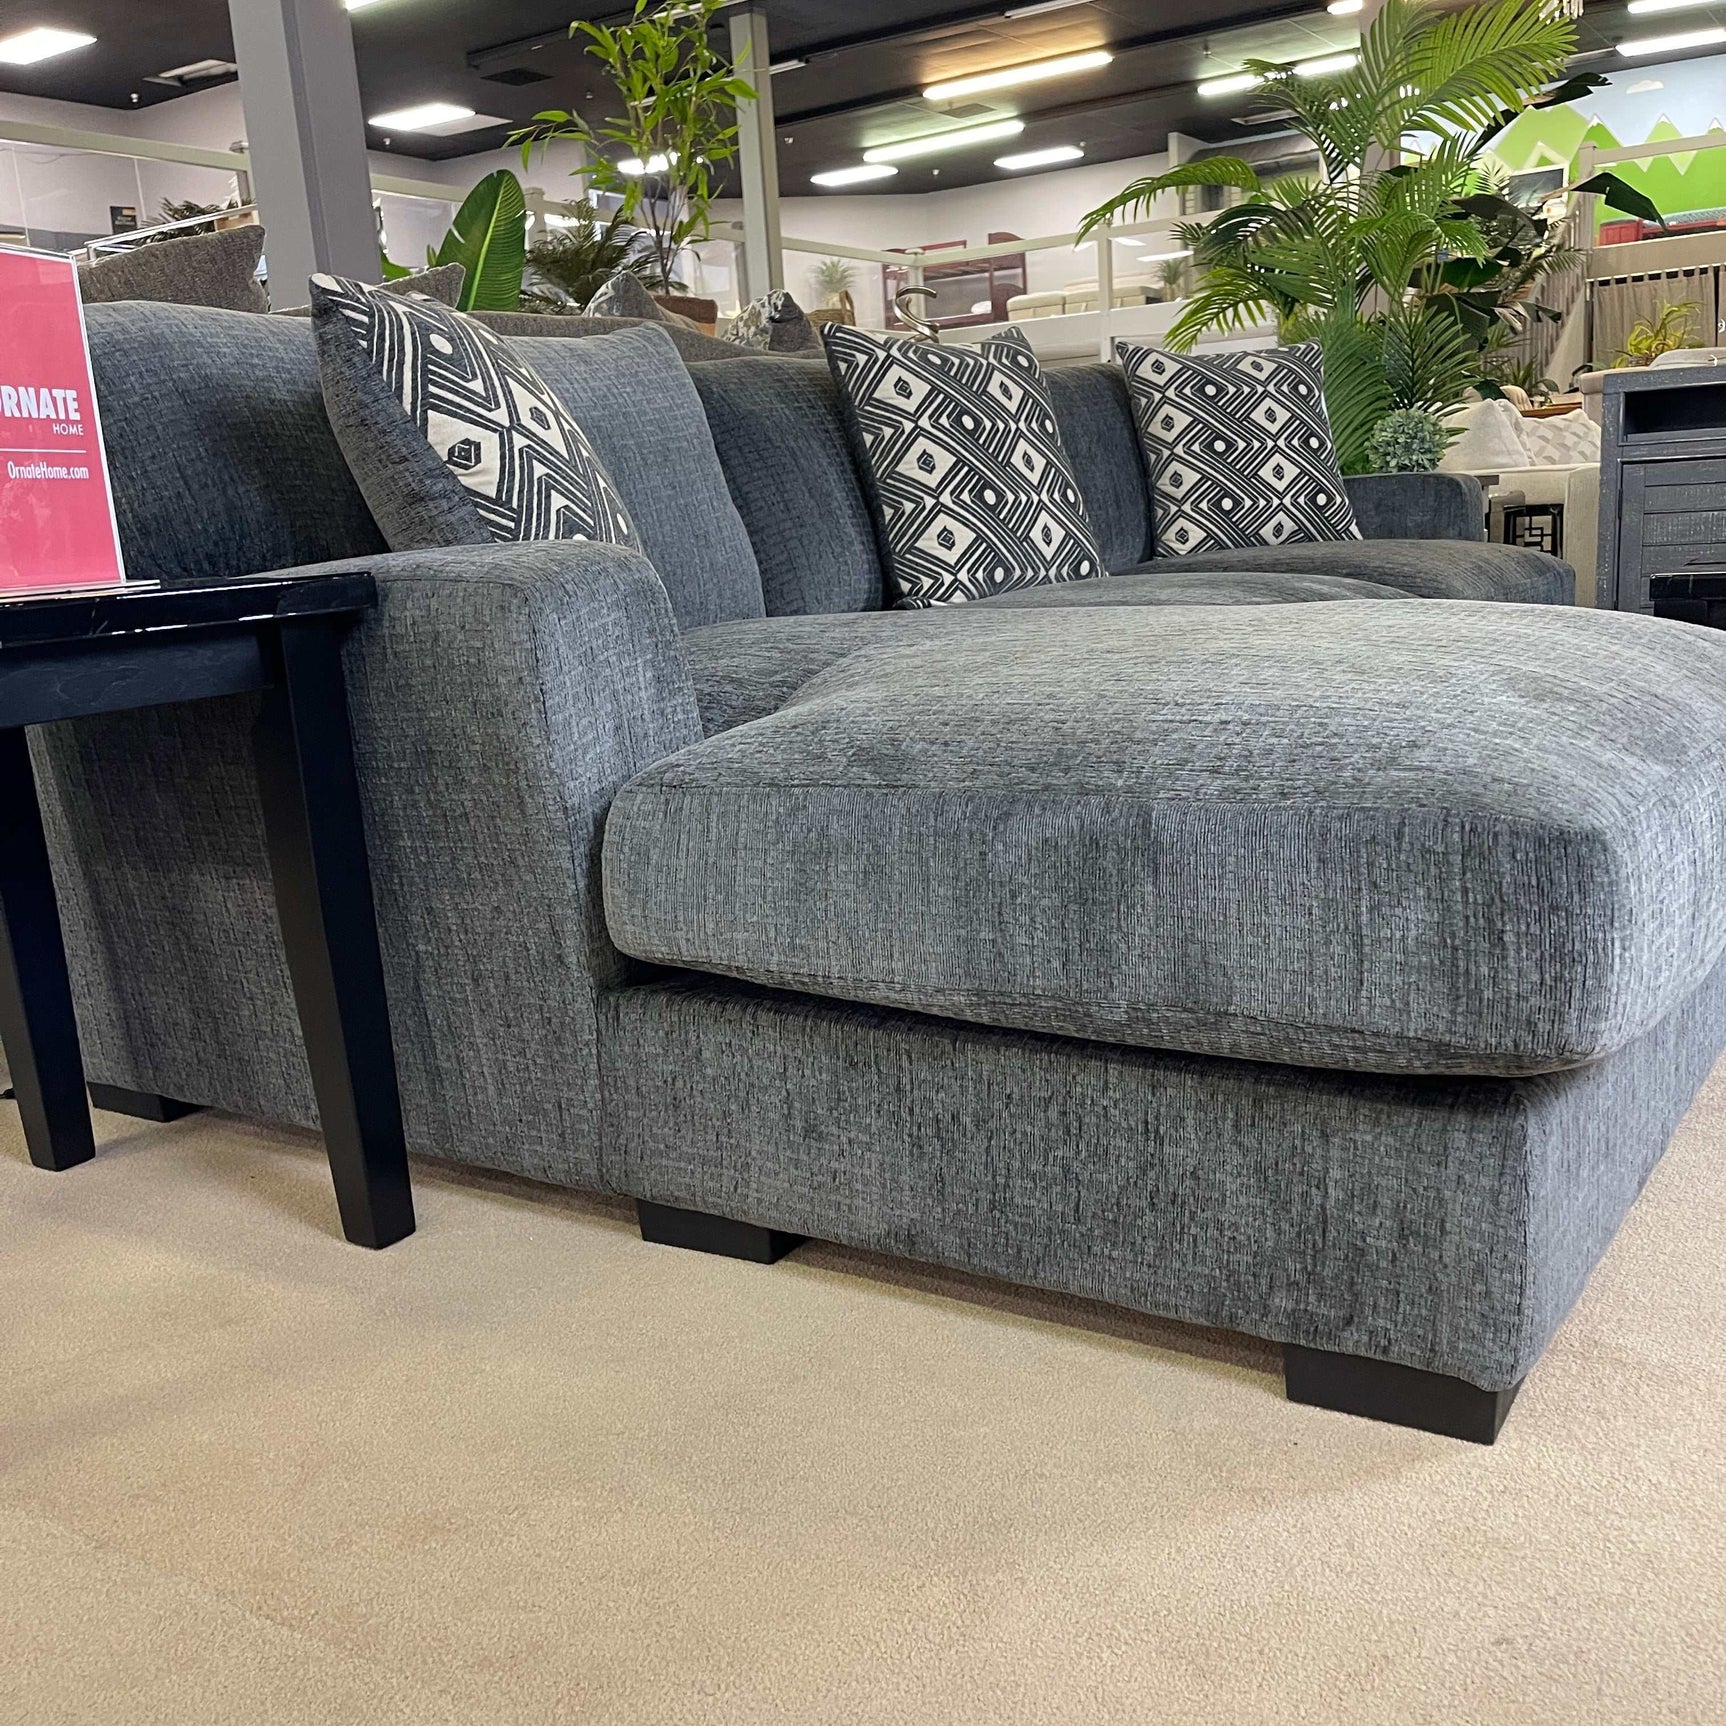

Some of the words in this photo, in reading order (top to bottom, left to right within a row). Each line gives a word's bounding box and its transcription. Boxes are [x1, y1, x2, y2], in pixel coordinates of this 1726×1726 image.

[0, 385, 81, 421] RNATE
[52, 423, 84, 436] HOME
[7, 461, 89, 479] OrnateHome.com
